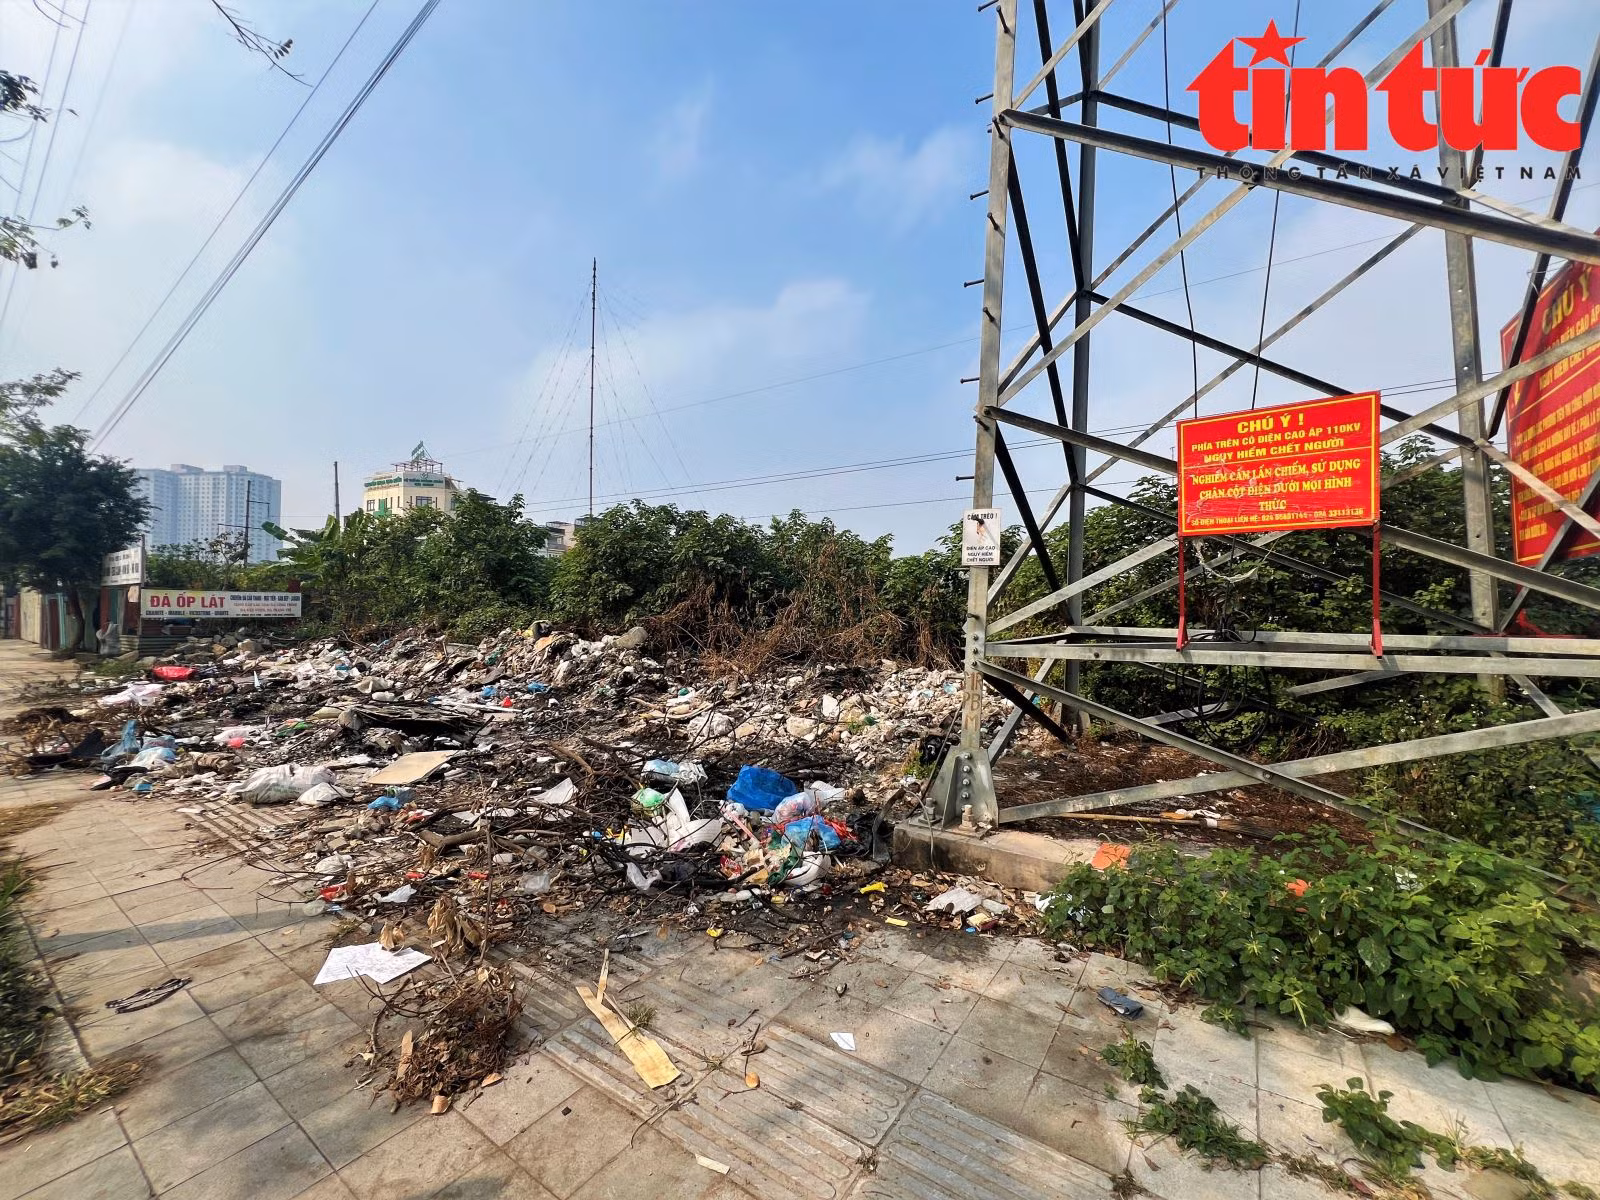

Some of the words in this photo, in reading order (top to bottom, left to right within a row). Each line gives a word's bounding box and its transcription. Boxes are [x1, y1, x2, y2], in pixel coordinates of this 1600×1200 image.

[1237, 416, 1274, 434] CHÚ
[1280, 412, 1292, 428] Ý
[1298, 413, 1305, 426] !
[1192, 440, 1213, 452] PHÍA
[1216, 438, 1239, 449] TRÊN
[1257, 432, 1282, 444] ĐIỆN
[1284, 429, 1306, 440] CAO
[1308, 427, 1323, 437] ÁP
[1327, 423, 1361, 435] 110KV
[1237, 445, 1267, 459] HIỂM
[1270, 442, 1300, 455] CHẾT
[1304, 437, 1345, 451] NGƯỜI
[1229, 466, 1250, 481] CẤM
[1311, 458, 1326, 472] SỬ
[1329, 458, 1361, 473] DỤNG
[1199, 487, 1227, 501] CHÂN
[1227, 484, 1247, 499] CỘT
[1247, 483, 1271, 498] ĐIỆN
[1273, 480, 1300, 494] DƯỚI
[1302, 480, 1322, 493] MỌI
[1324, 476, 1352, 489] HÌNH
[1258, 498, 1287, 511] THỨC
[150, 593, 171, 608] ĐÁ
[177, 592, 196, 608] ỐP
[201, 594, 225, 609] LÁT
